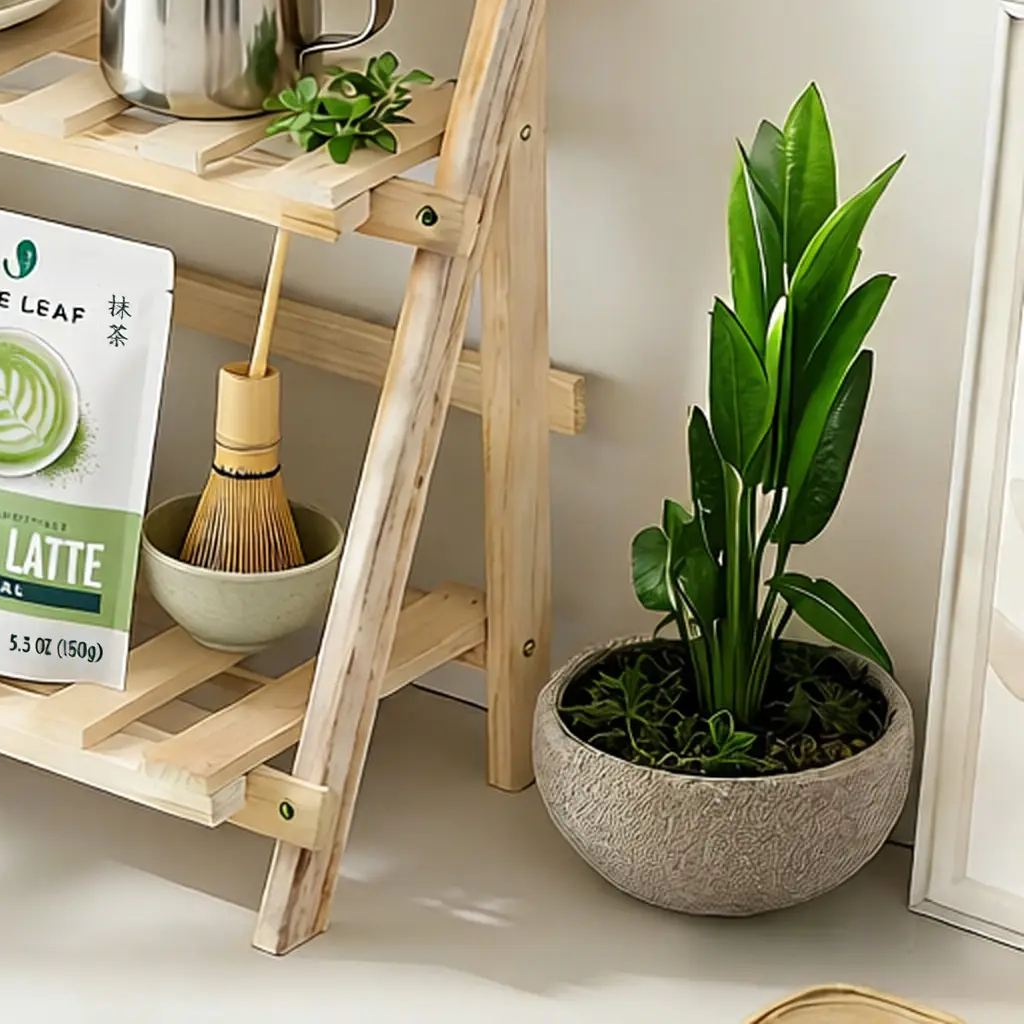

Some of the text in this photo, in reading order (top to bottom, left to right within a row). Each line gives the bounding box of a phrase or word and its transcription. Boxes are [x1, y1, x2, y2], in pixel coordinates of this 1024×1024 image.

[21, 295, 86, 324] LEAF
[106, 293, 132, 348] 抹茶
[6, 528, 105, 588] LATTE
[35, 637, 52, 656] OZ
[57, 638, 104, 663] (150g)
